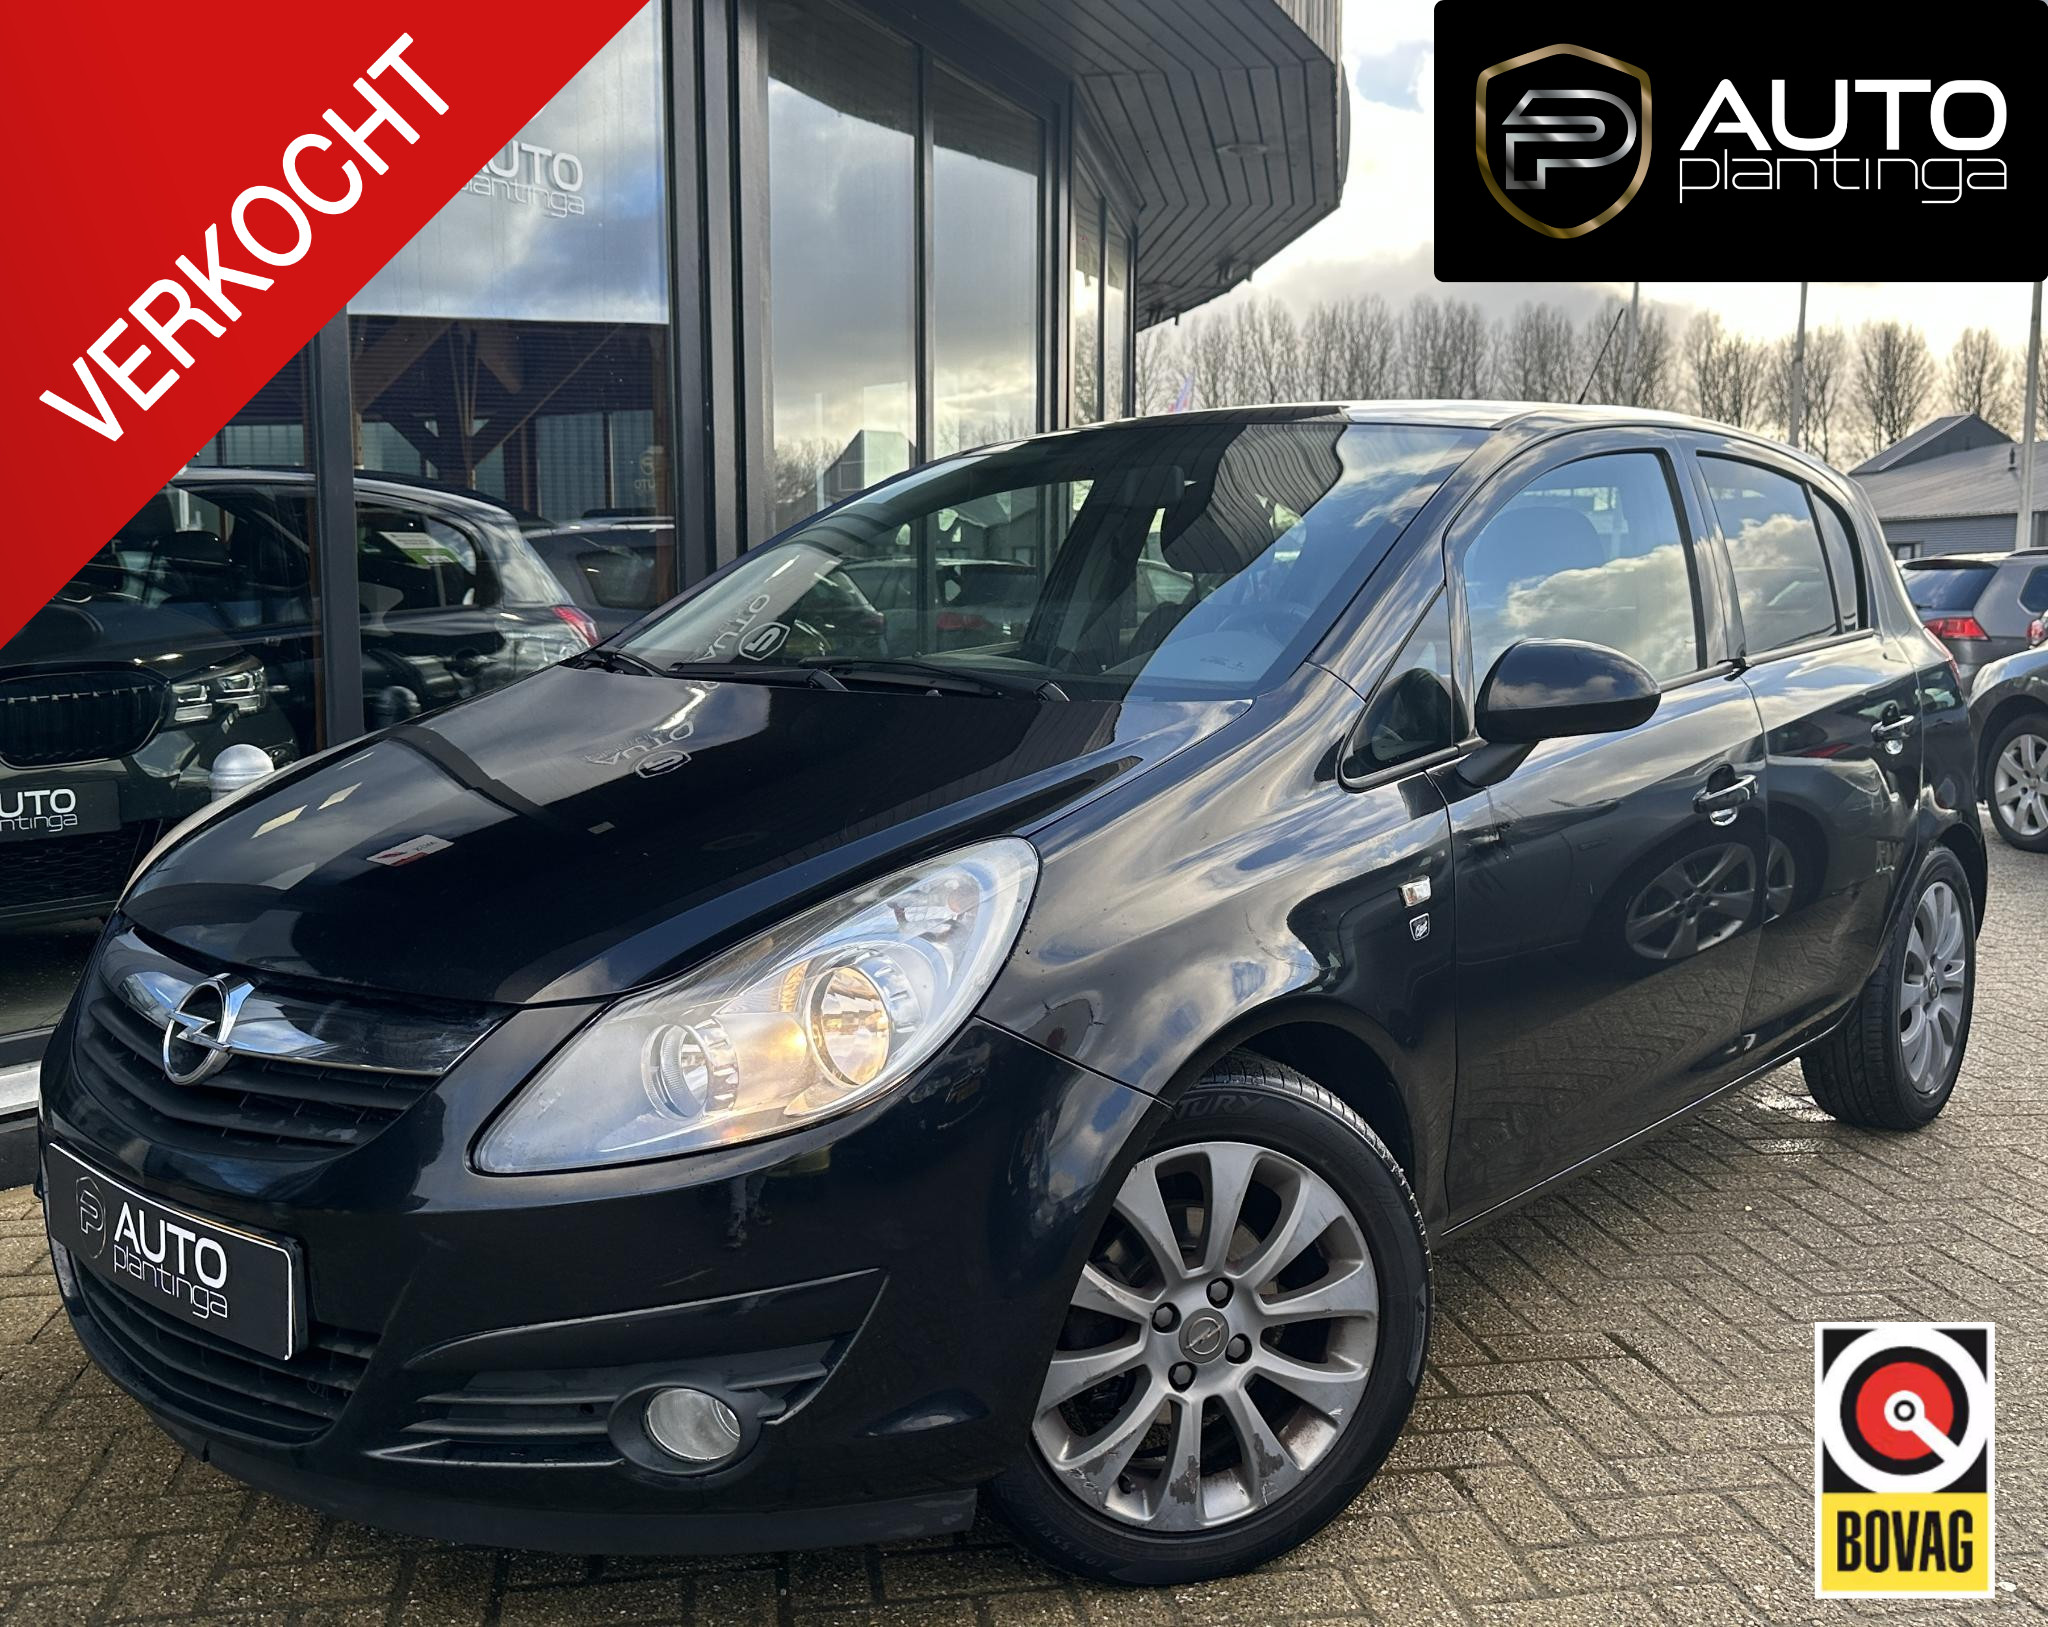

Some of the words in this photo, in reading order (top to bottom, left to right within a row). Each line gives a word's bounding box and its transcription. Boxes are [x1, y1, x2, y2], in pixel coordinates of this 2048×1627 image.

[481, 140, 584, 192] UTO
[113, 1201, 228, 1289] AUTO
[113, 1244, 228, 1319] plantinga
